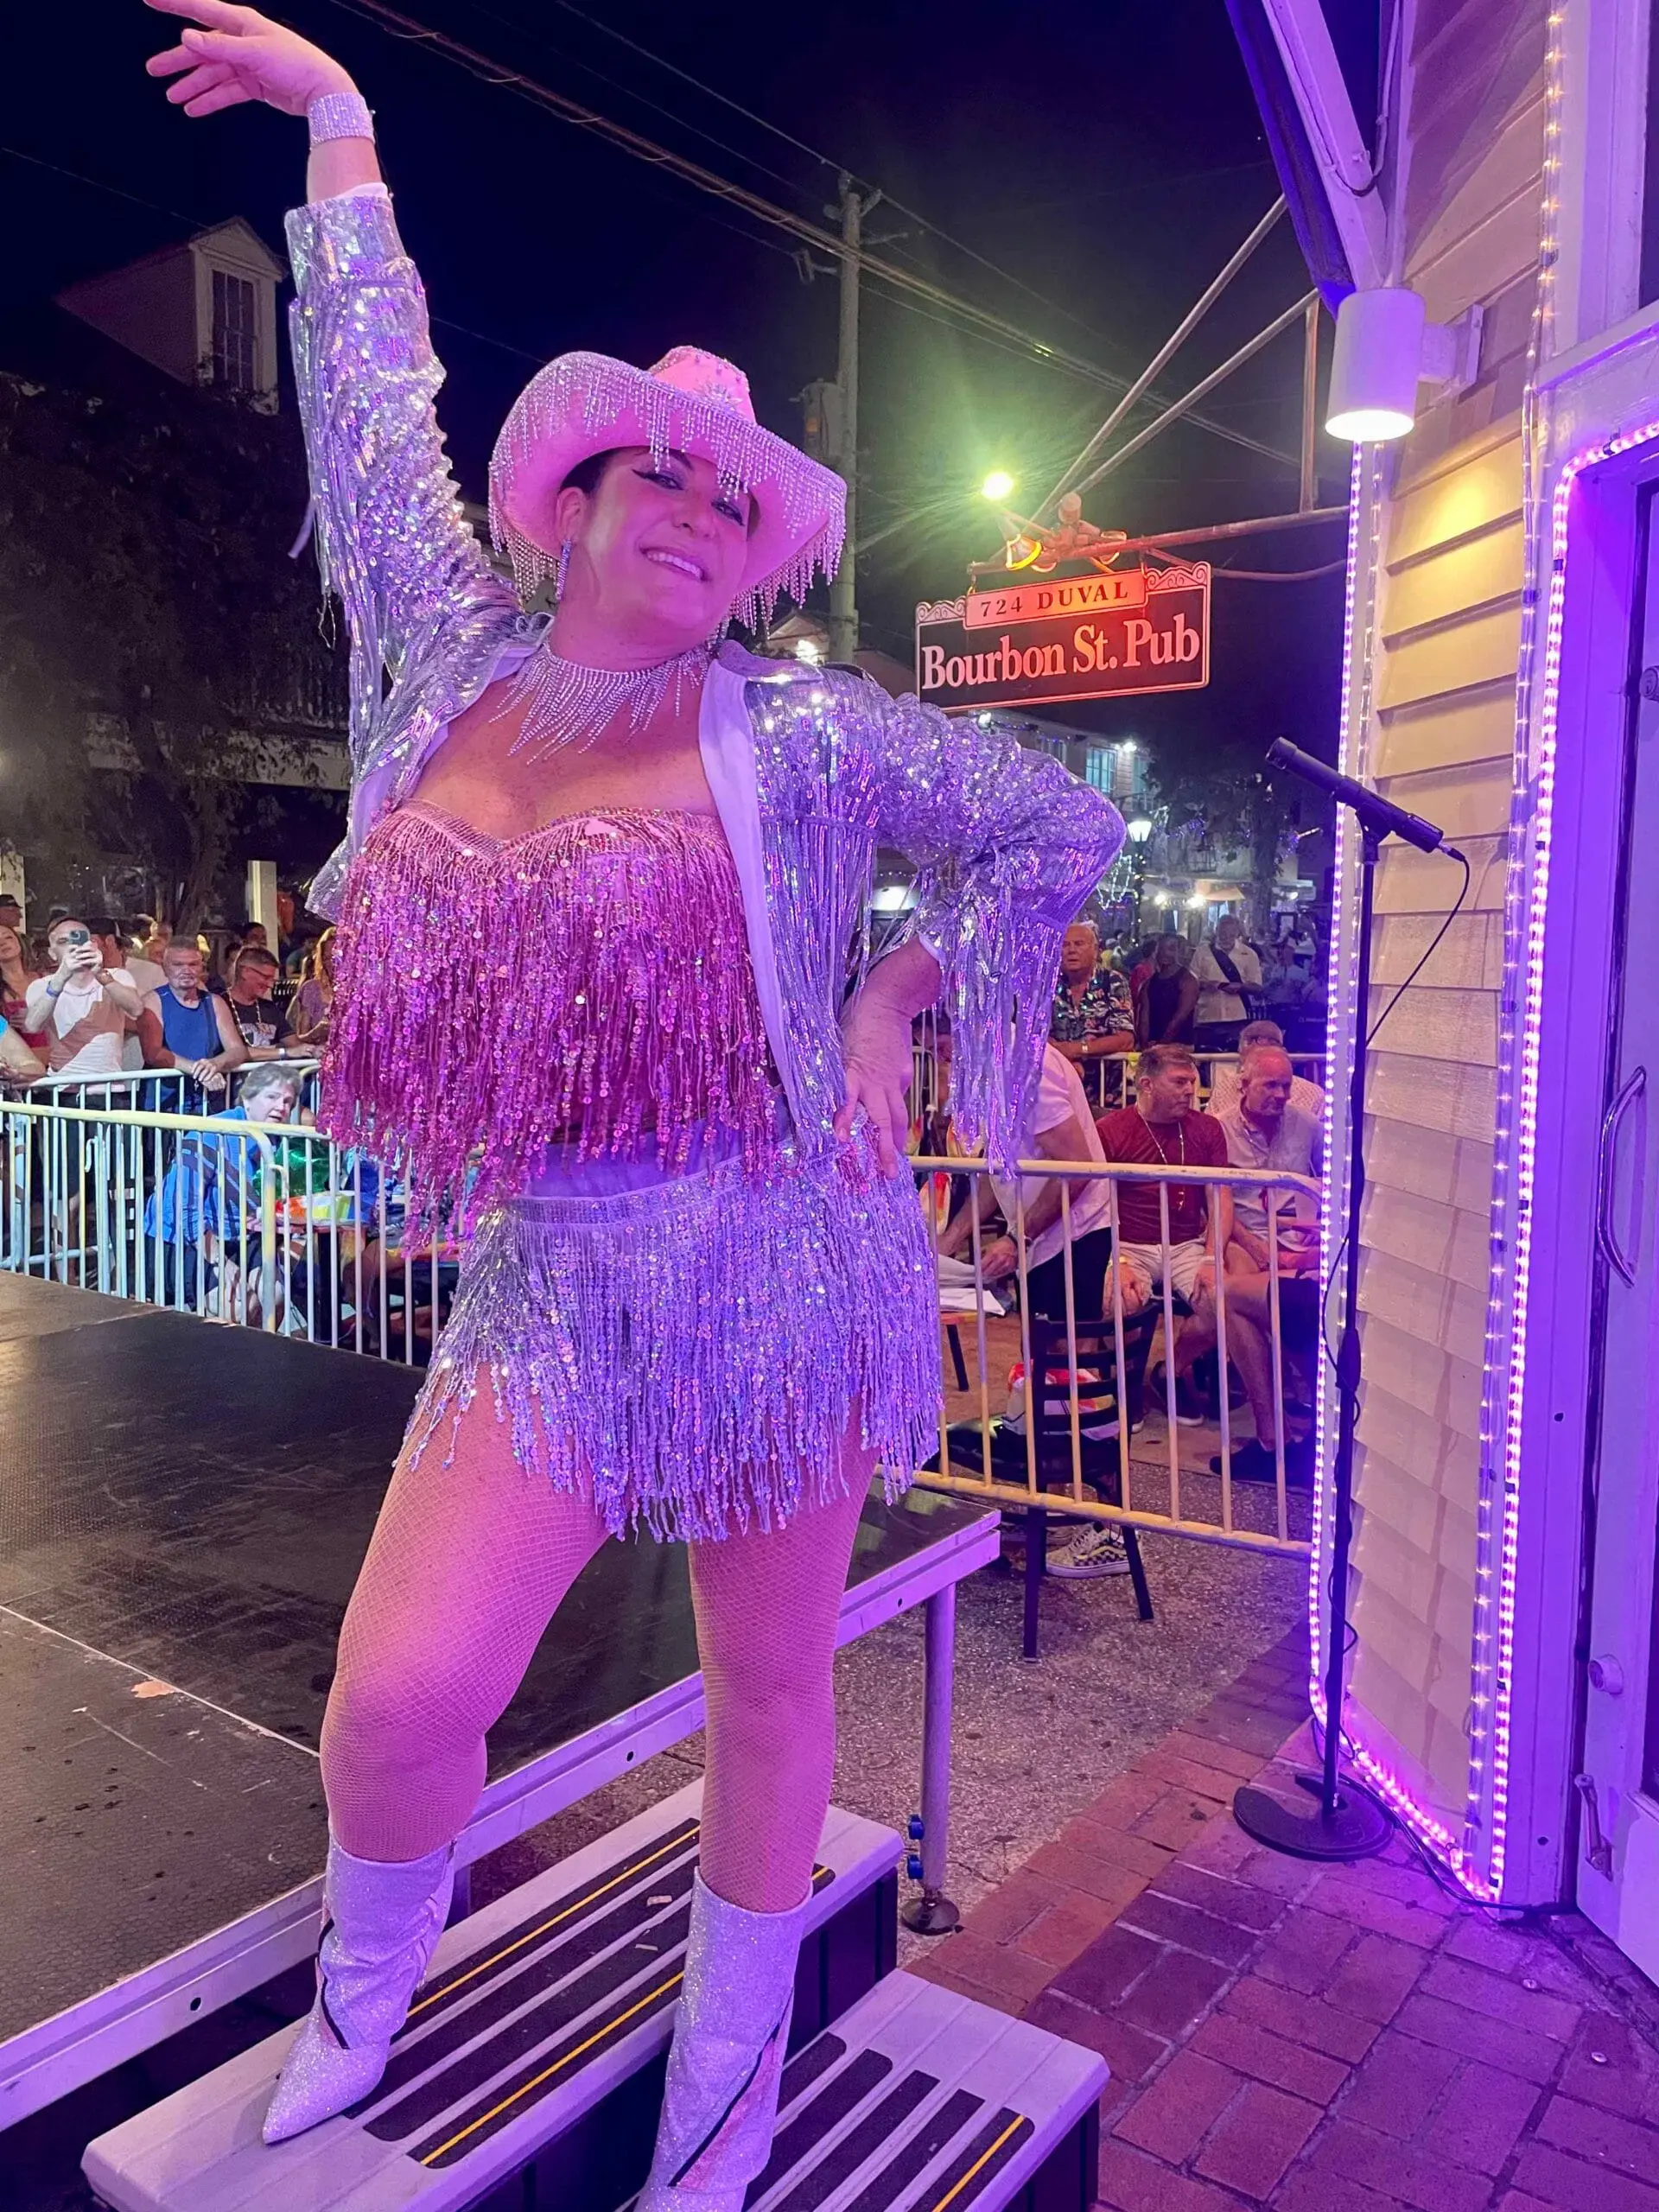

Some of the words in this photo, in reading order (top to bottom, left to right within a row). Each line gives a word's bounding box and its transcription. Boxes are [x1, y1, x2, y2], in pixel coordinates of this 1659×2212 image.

[981, 601, 1023, 618] 724
[1037, 582, 1128, 610] DUVAL
[921, 635, 1066, 690] Bourbon
[1072, 624, 1118, 673] St.
[1123, 613, 1200, 667] Pub
